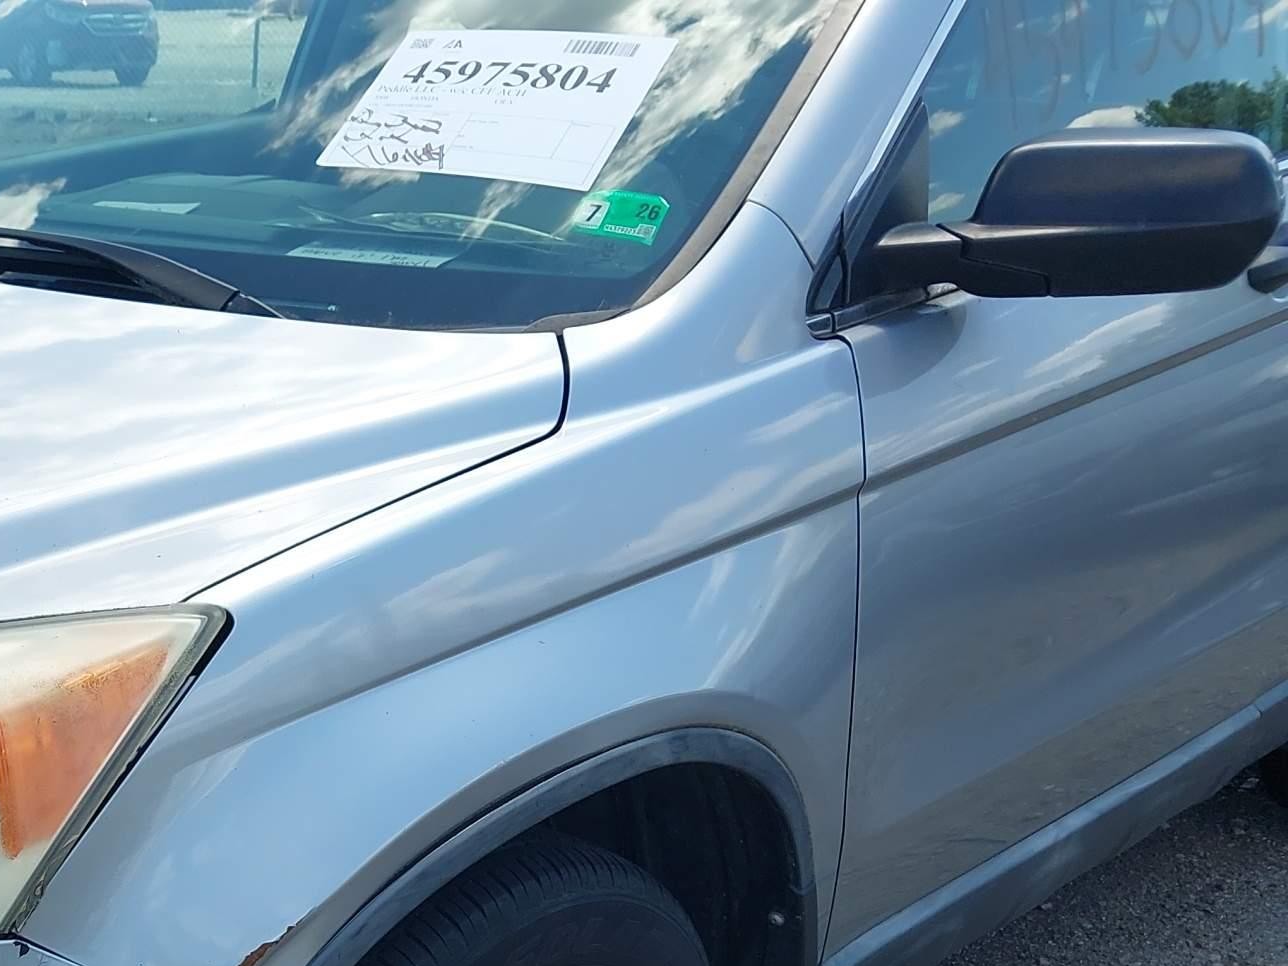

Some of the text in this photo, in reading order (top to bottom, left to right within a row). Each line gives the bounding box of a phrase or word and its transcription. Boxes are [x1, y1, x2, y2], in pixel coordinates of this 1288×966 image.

[402, 60, 618, 93] 45975804
[585, 203, 662, 222] 7 26
